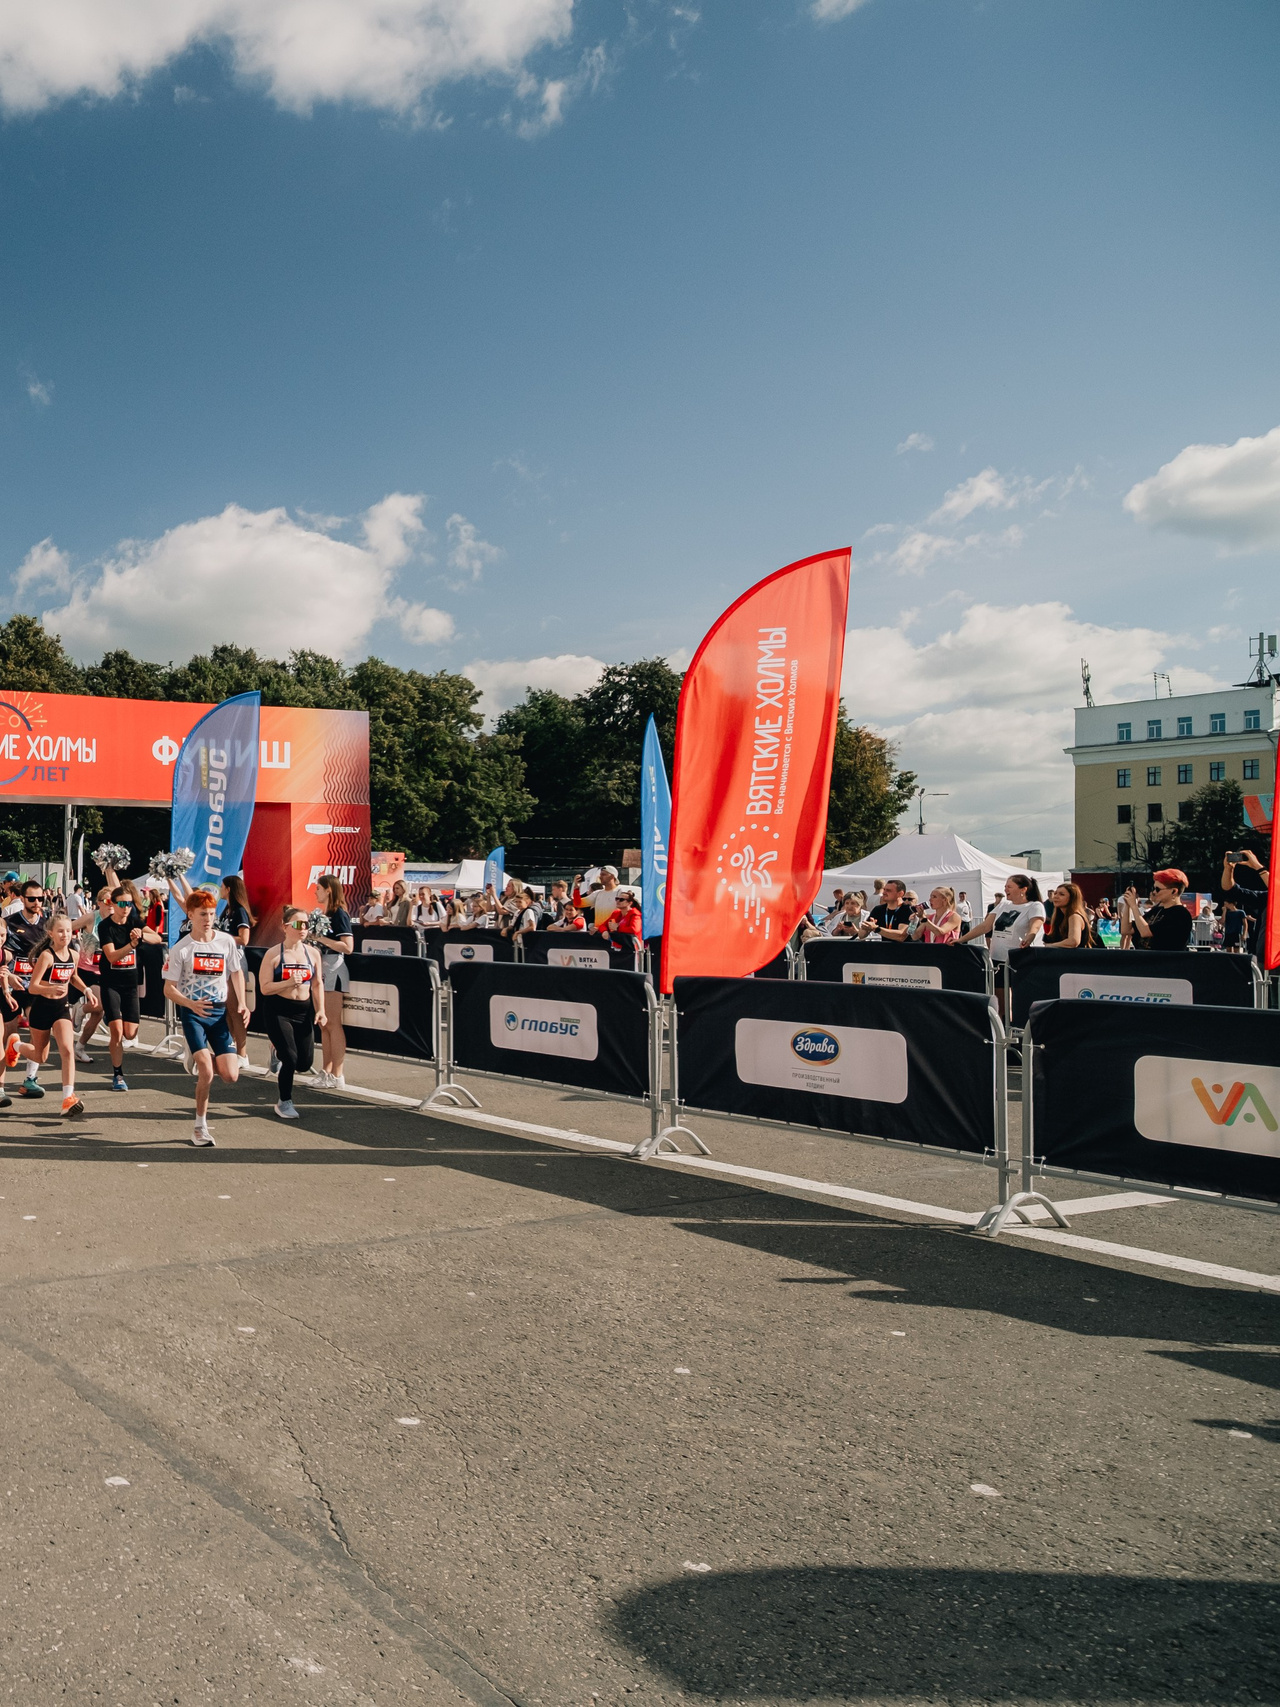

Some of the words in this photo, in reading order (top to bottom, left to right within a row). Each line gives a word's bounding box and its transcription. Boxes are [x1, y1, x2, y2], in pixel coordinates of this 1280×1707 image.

[756, 626, 787, 710] ХОЛМЫ
[787, 659, 799, 697] Холмов
[784, 697, 797, 735] Вятских
[26, 734, 97, 763] ХОЛМЫ
[31, 766, 70, 782] ЛЕТ
[745, 714, 783, 816] ВЯТСКИЕ
[779, 743, 792, 798] начинается
[203, 747, 228, 877] ГЛОБУС
[773, 797, 785, 816] Все
[333, 826, 361, 834] GEELY
[198, 958, 220, 968] 1452
[520, 1018, 580, 1037] ГЛОБУС
[795, 1036, 836, 1055] Здрава
[791, 1072, 841, 1084] ПРОИЗВОДСТВЕННЫЙ
